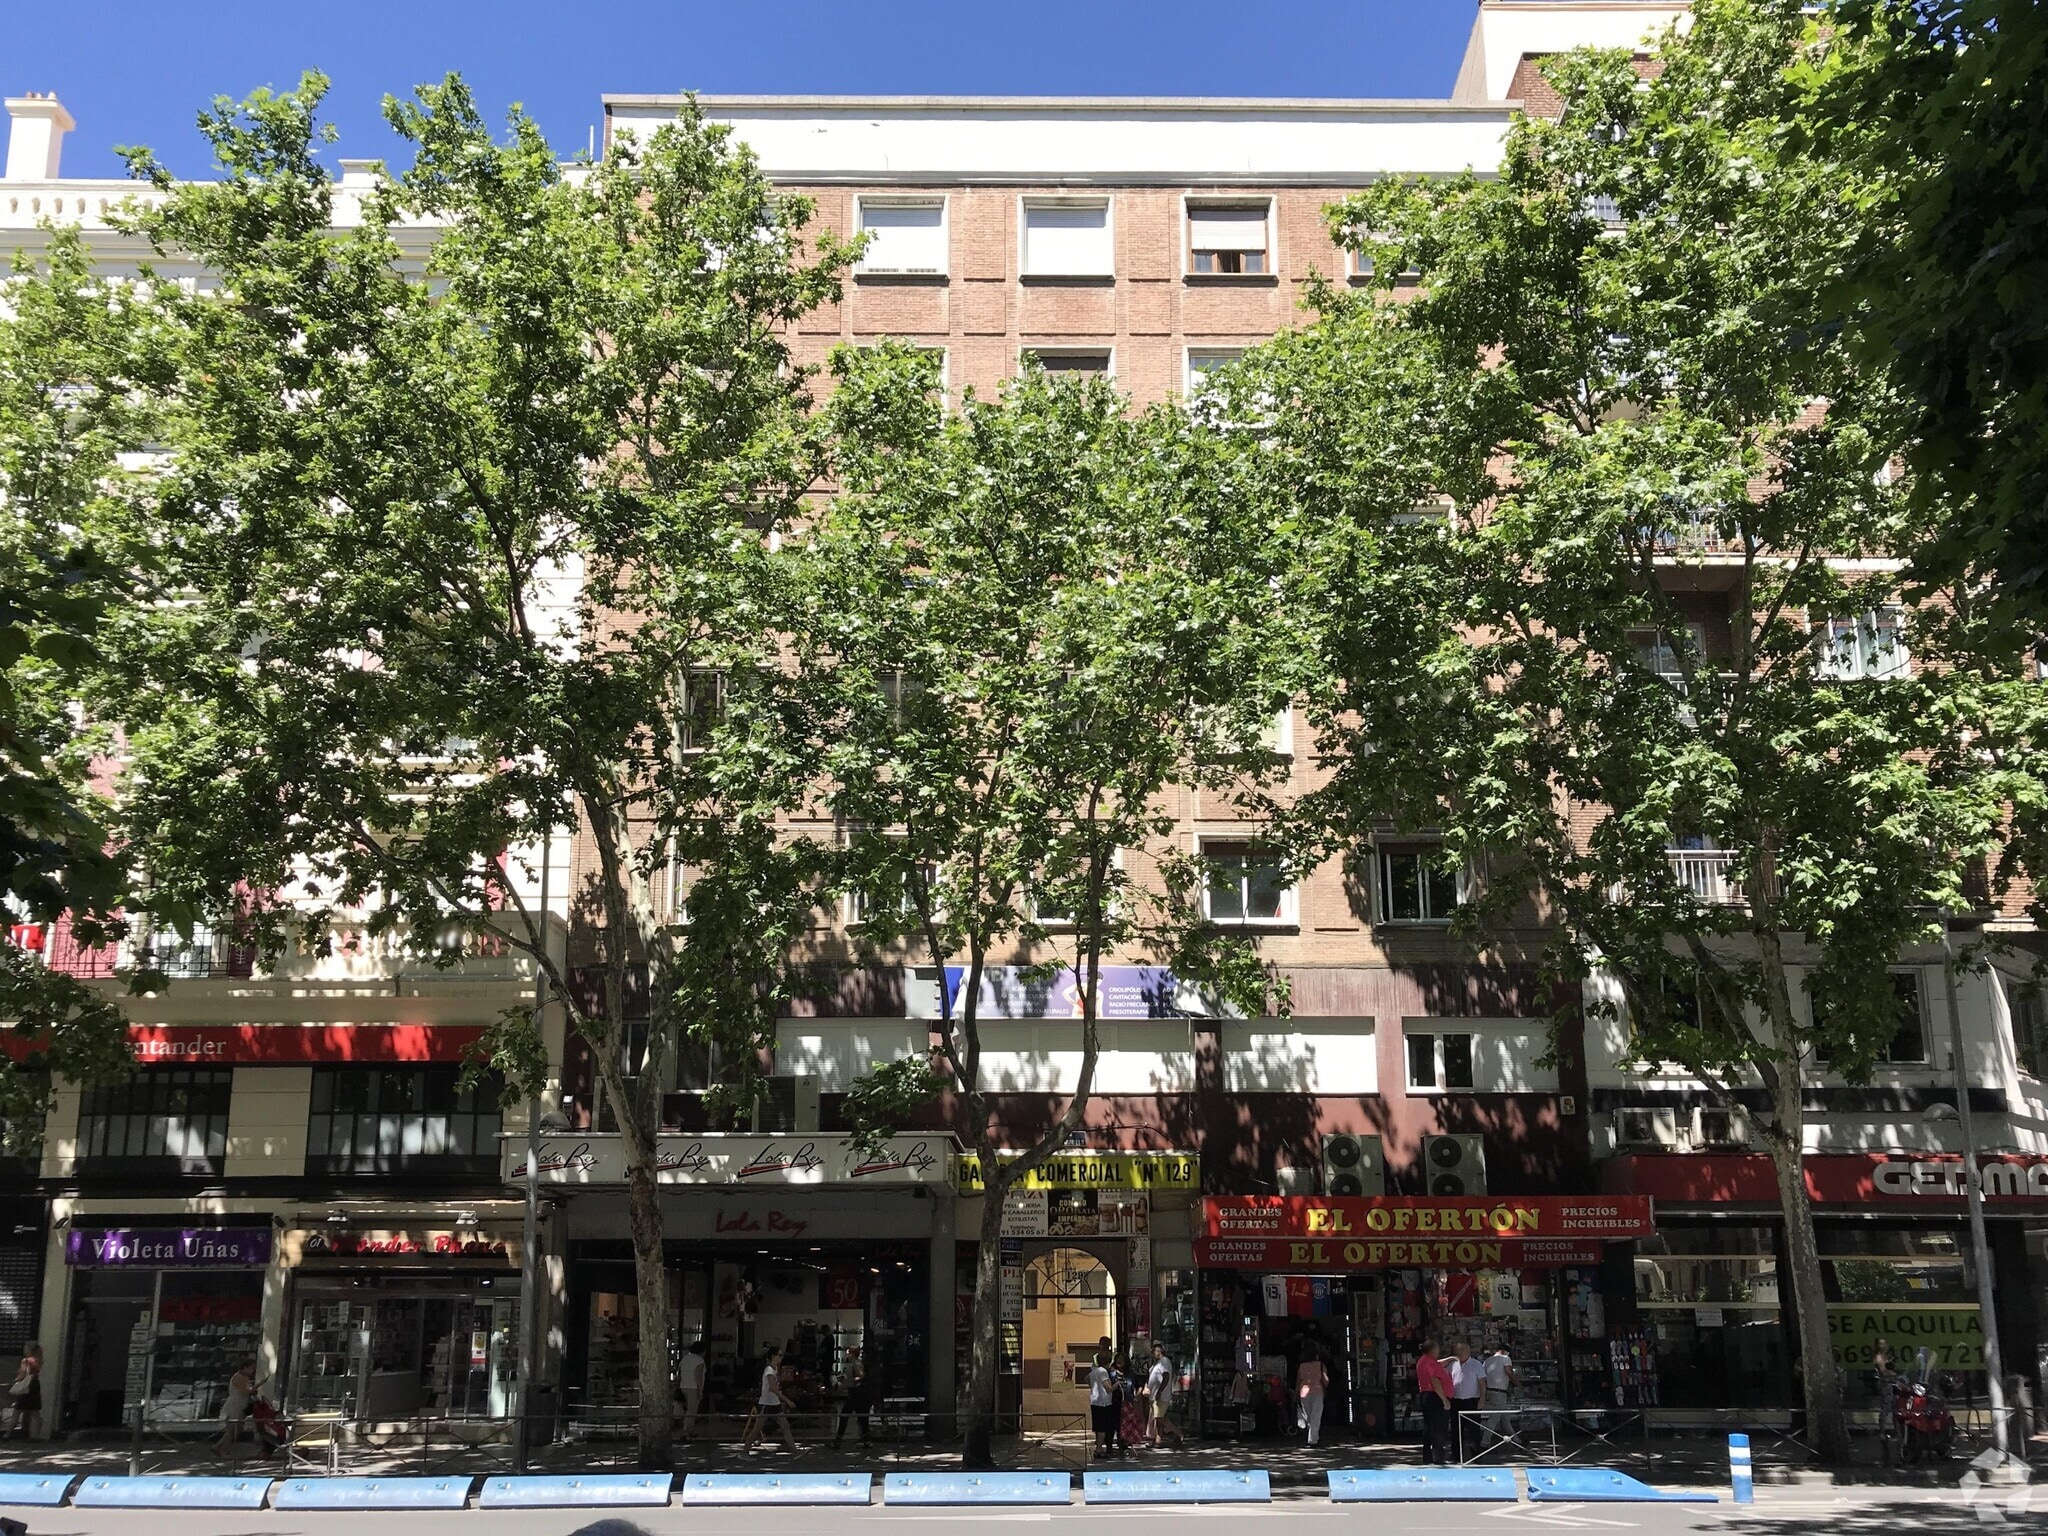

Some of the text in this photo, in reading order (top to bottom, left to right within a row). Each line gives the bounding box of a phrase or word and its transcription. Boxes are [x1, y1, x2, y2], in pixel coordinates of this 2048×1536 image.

[122, 1033, 227, 1056] antander
[564, 1142, 600, 1174] Rey
[677, 1142, 710, 1174] Rey
[744, 1141, 826, 1173] Lola Rey
[902, 1141, 938, 1173] Rey
[1036, 1162, 1124, 1182] COMERCIAL
[1219, 1207, 1282, 1217] GRANDES
[1307, 1203, 1540, 1232] EL OFERTÓN
[1562, 1207, 1618, 1217] PRECIOS
[715, 1210, 808, 1238] Lola Rey
[1219, 1219, 1279, 1230] OFERTAS
[1562, 1218, 1641, 1229] INCREIBLES
[91, 1236, 239, 1259] Violeta Uñas
[1209, 1241, 1267, 1251] GRANDES
[1289, 1242, 1330, 1264] EL
[1522, 1241, 1574, 1251] PRECIOS
[1209, 1252, 1264, 1262] OFERTAS
[1523, 1252, 1595, 1262] INCREIBLES
[831, 1278, 859, 1307] 50
[1827, 1315, 1983, 1336] SE ALQUILA
